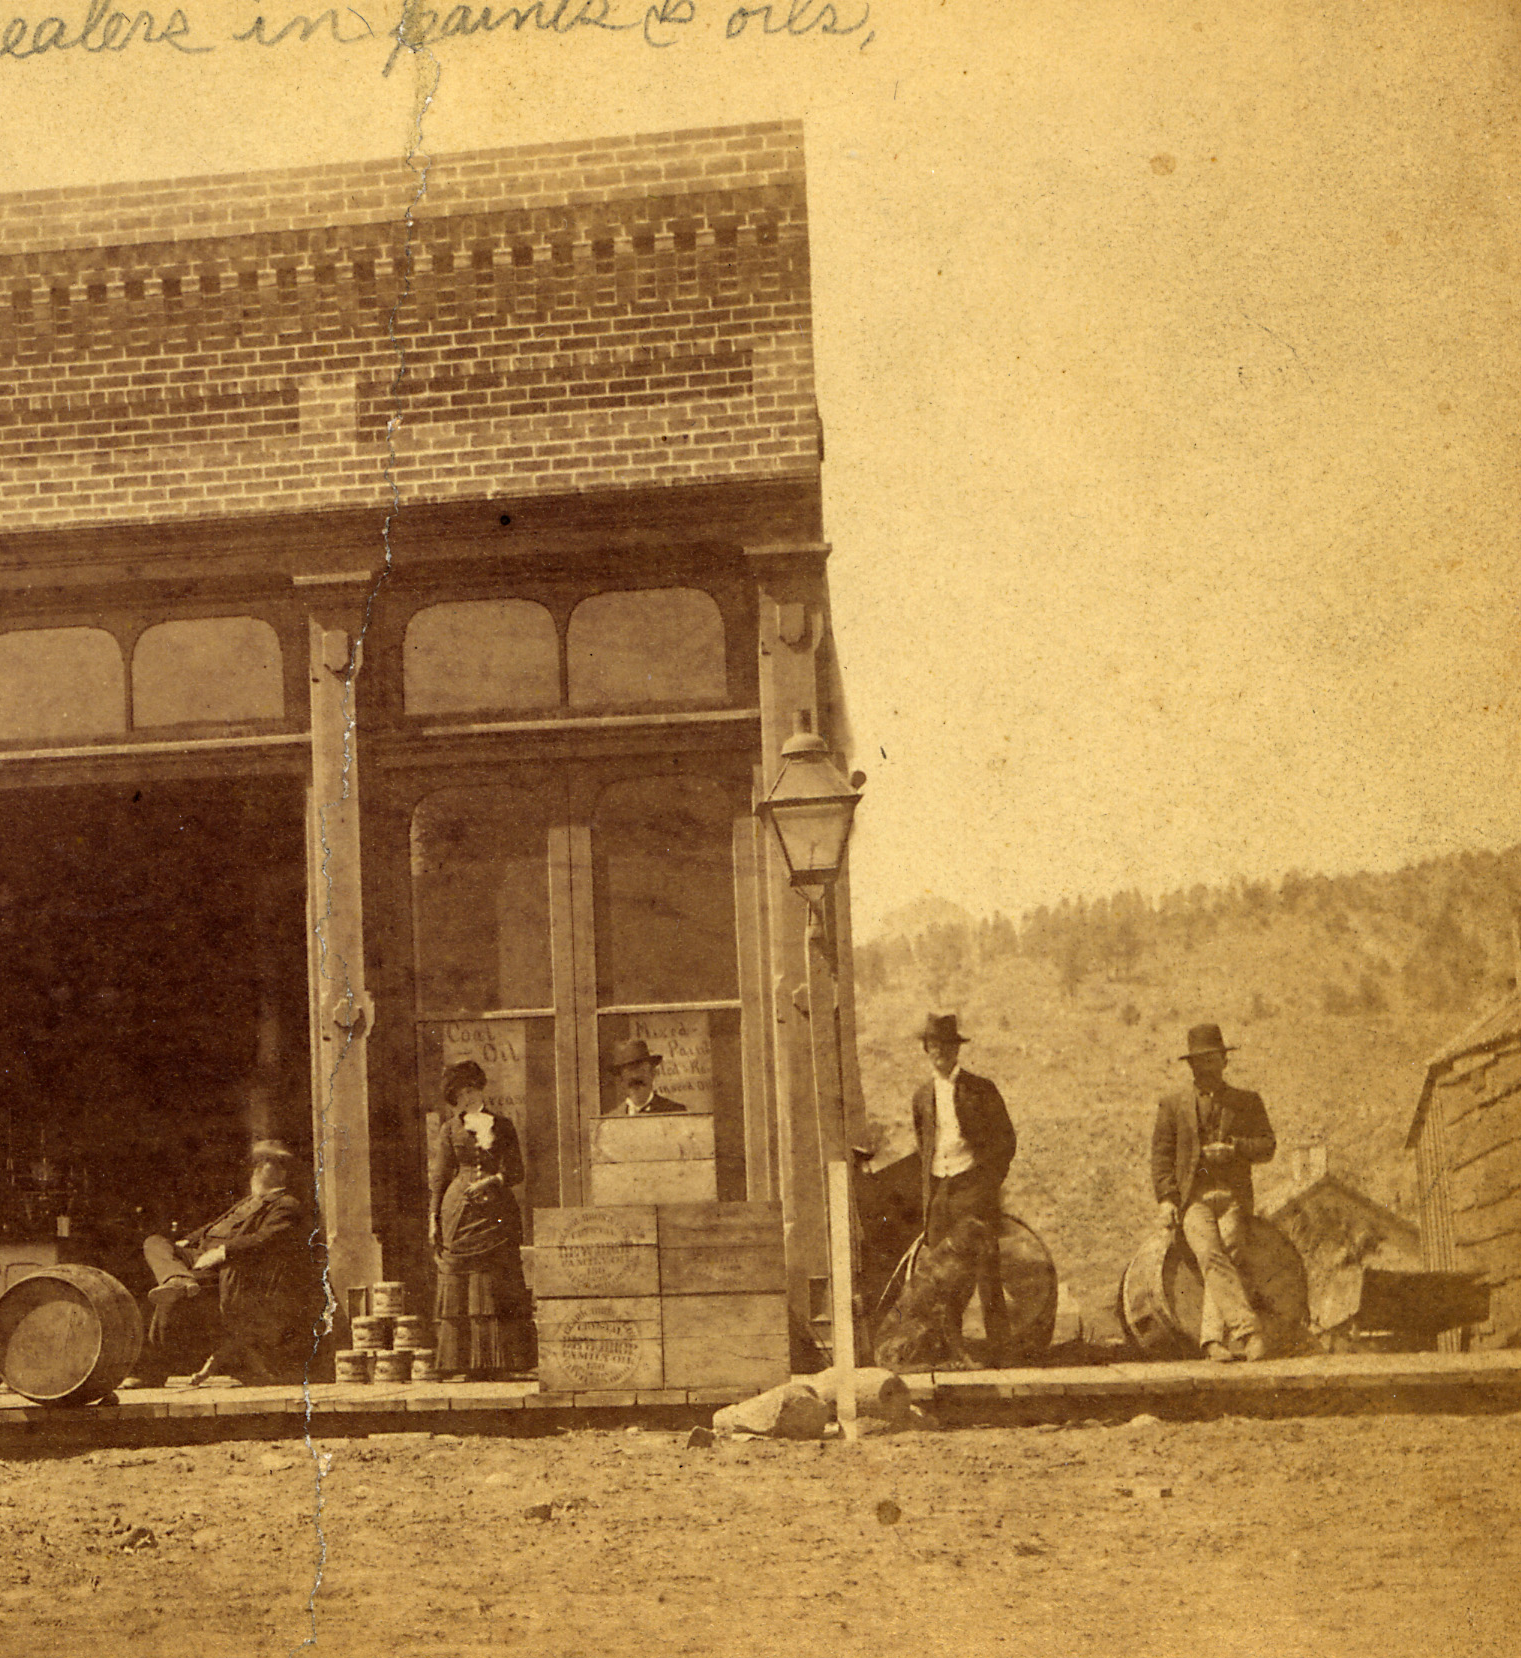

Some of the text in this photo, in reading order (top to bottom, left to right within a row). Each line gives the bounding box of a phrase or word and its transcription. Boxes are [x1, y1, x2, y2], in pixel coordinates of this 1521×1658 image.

[231, 12, 376, 48] in
[447, 1022, 496, 1043] Coal
[483, 1041, 520, 1063] Oil
